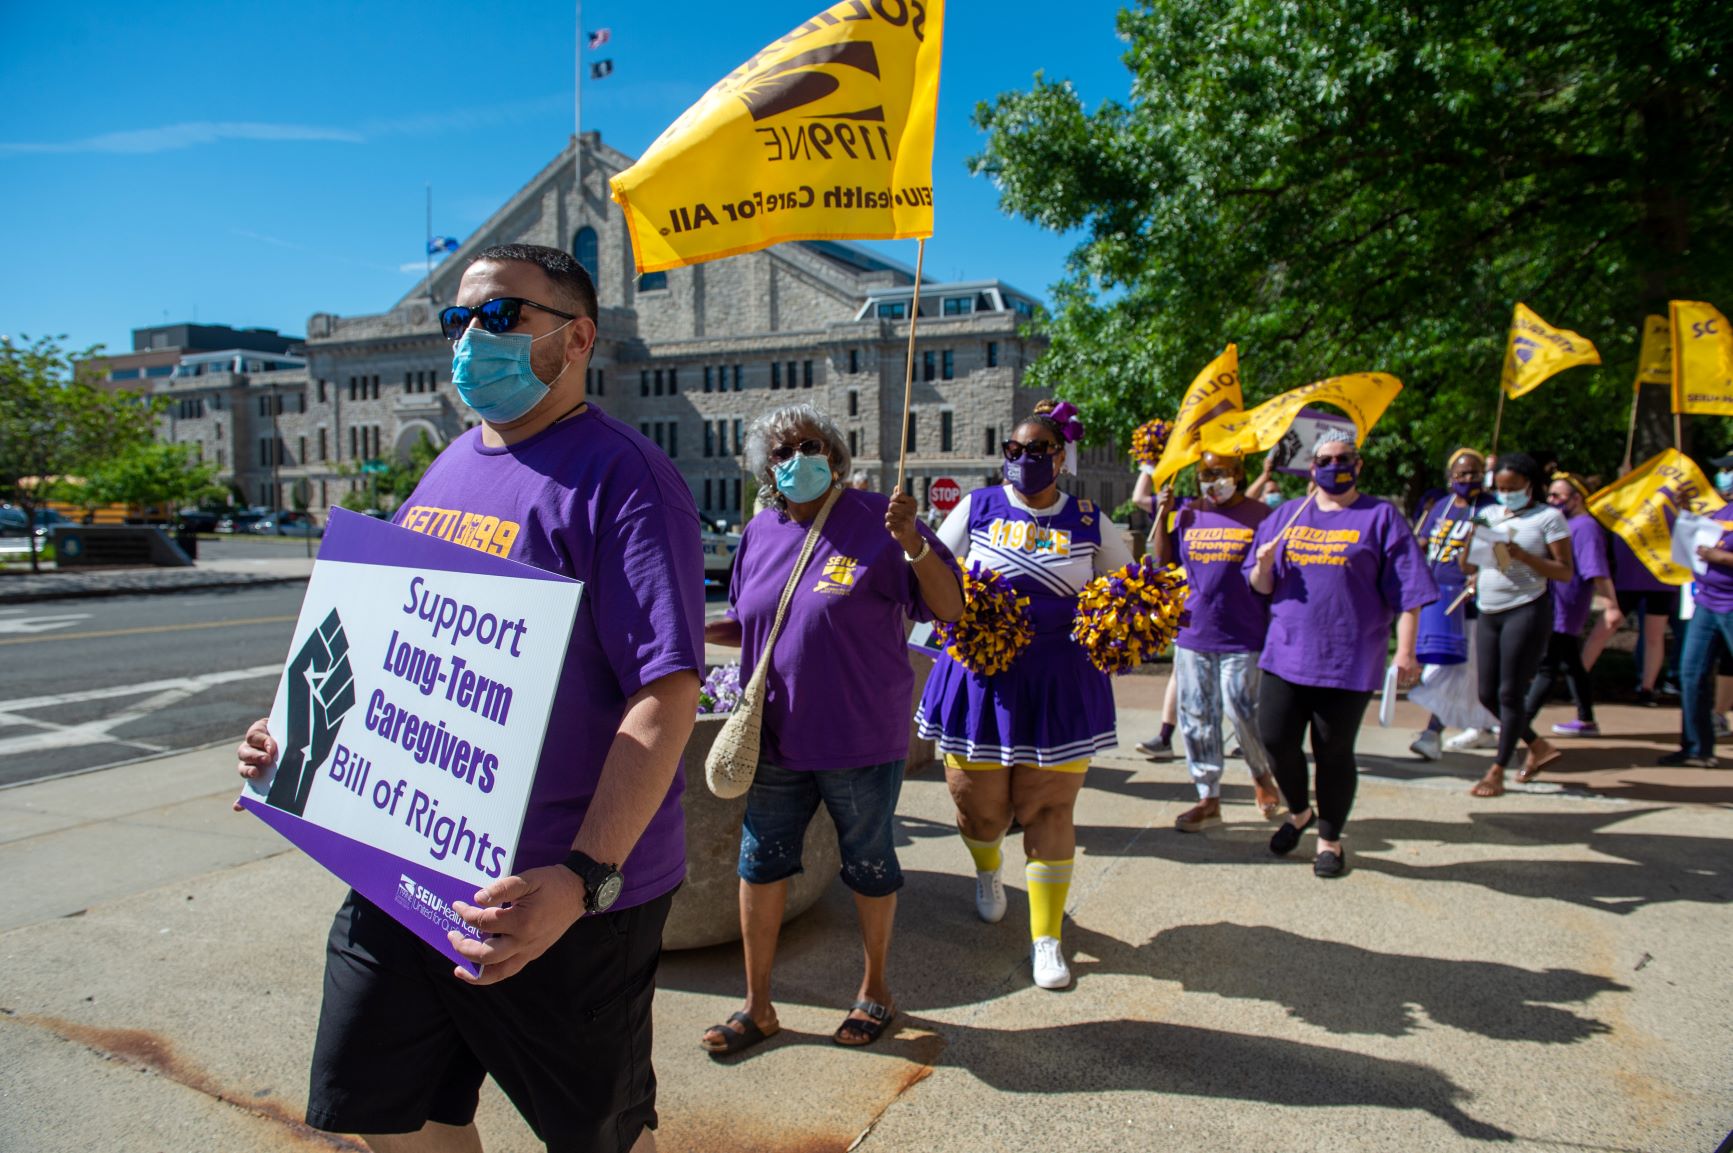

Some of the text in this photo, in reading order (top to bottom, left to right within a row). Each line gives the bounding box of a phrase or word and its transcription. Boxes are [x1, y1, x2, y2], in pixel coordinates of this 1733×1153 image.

[932, 486, 960, 502] STOP
[1189, 541, 1246, 552] Stronger
[1286, 539, 1349, 554] Stronger
[826, 555, 859, 567] SEIU
[1188, 550, 1245, 564] Together
[402, 576, 528, 658] Support
[382, 629, 514, 727] Long-Term
[364, 688, 500, 794] Caregivers
[328, 743, 508, 879] Bill of Rights
